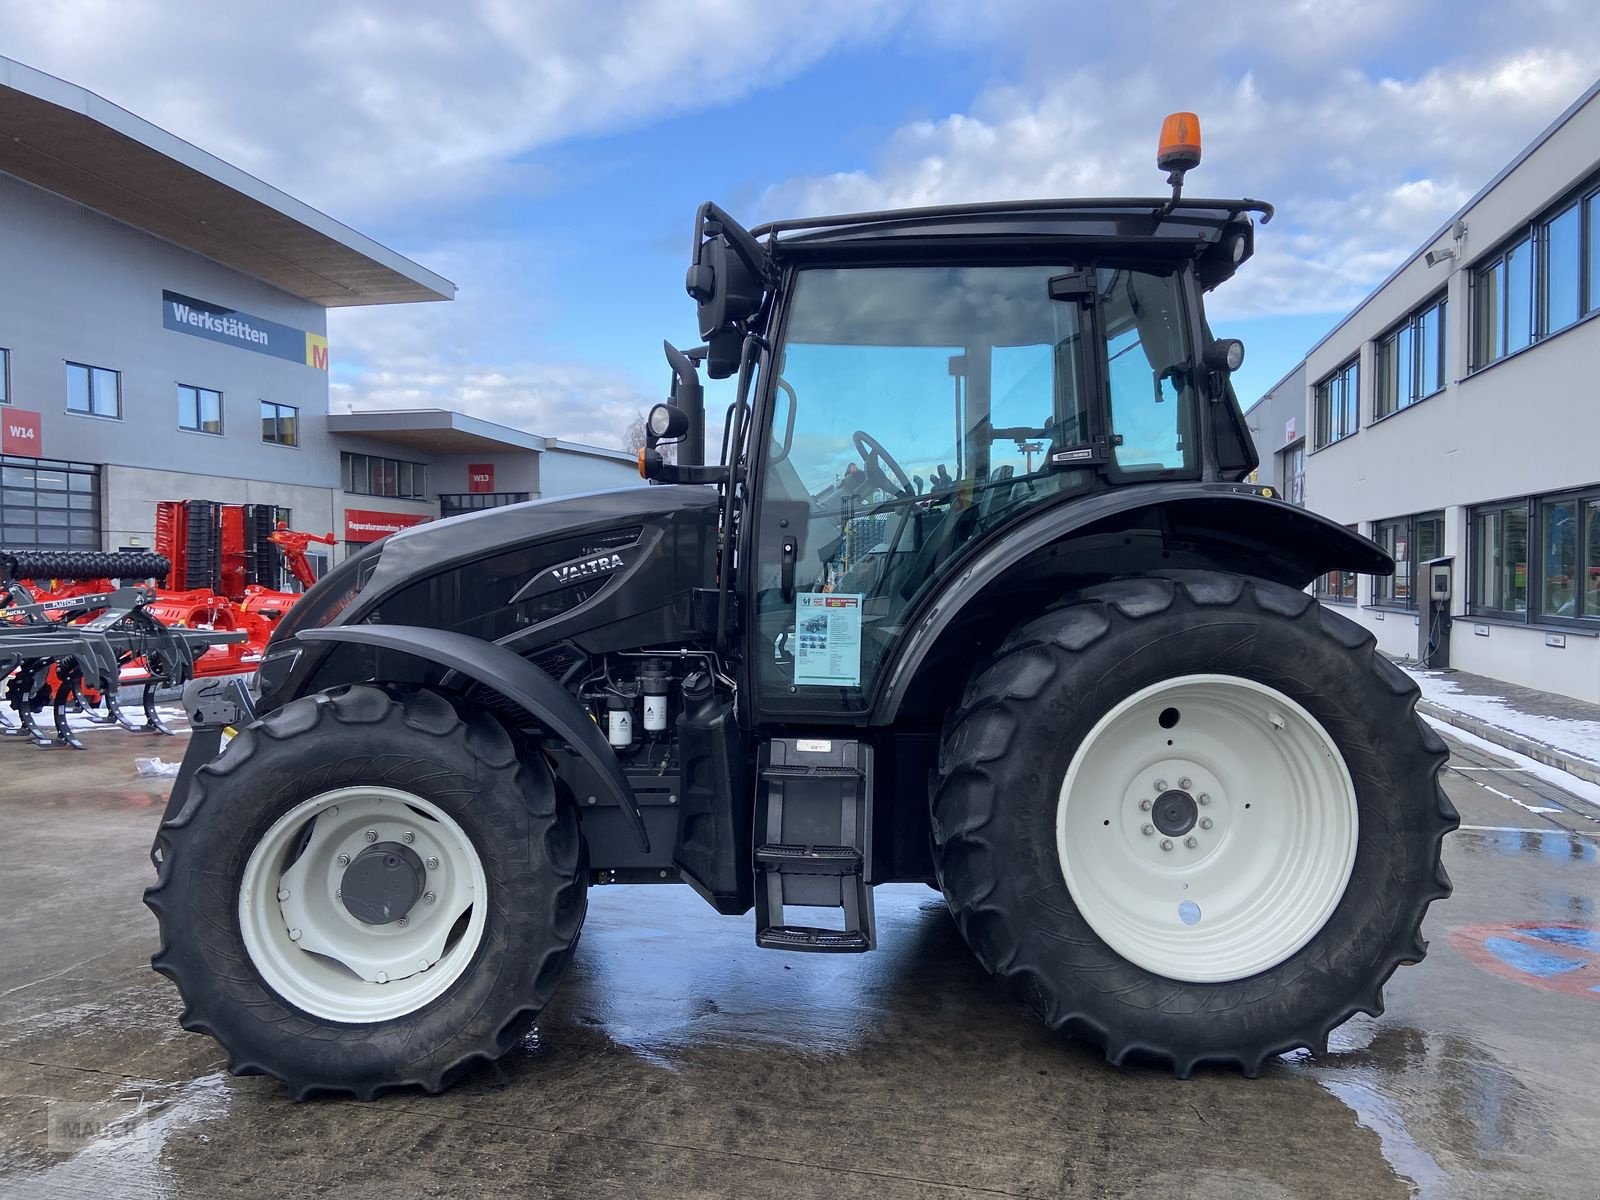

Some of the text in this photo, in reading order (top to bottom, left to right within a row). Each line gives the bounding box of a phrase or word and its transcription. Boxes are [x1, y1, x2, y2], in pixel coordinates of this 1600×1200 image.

[172, 302, 269, 346] Werkstätten
[312, 344, 329, 372] M
[9, 425, 35, 440] W14
[473, 474, 490, 482] W13
[552, 553, 625, 583] VALTRA
